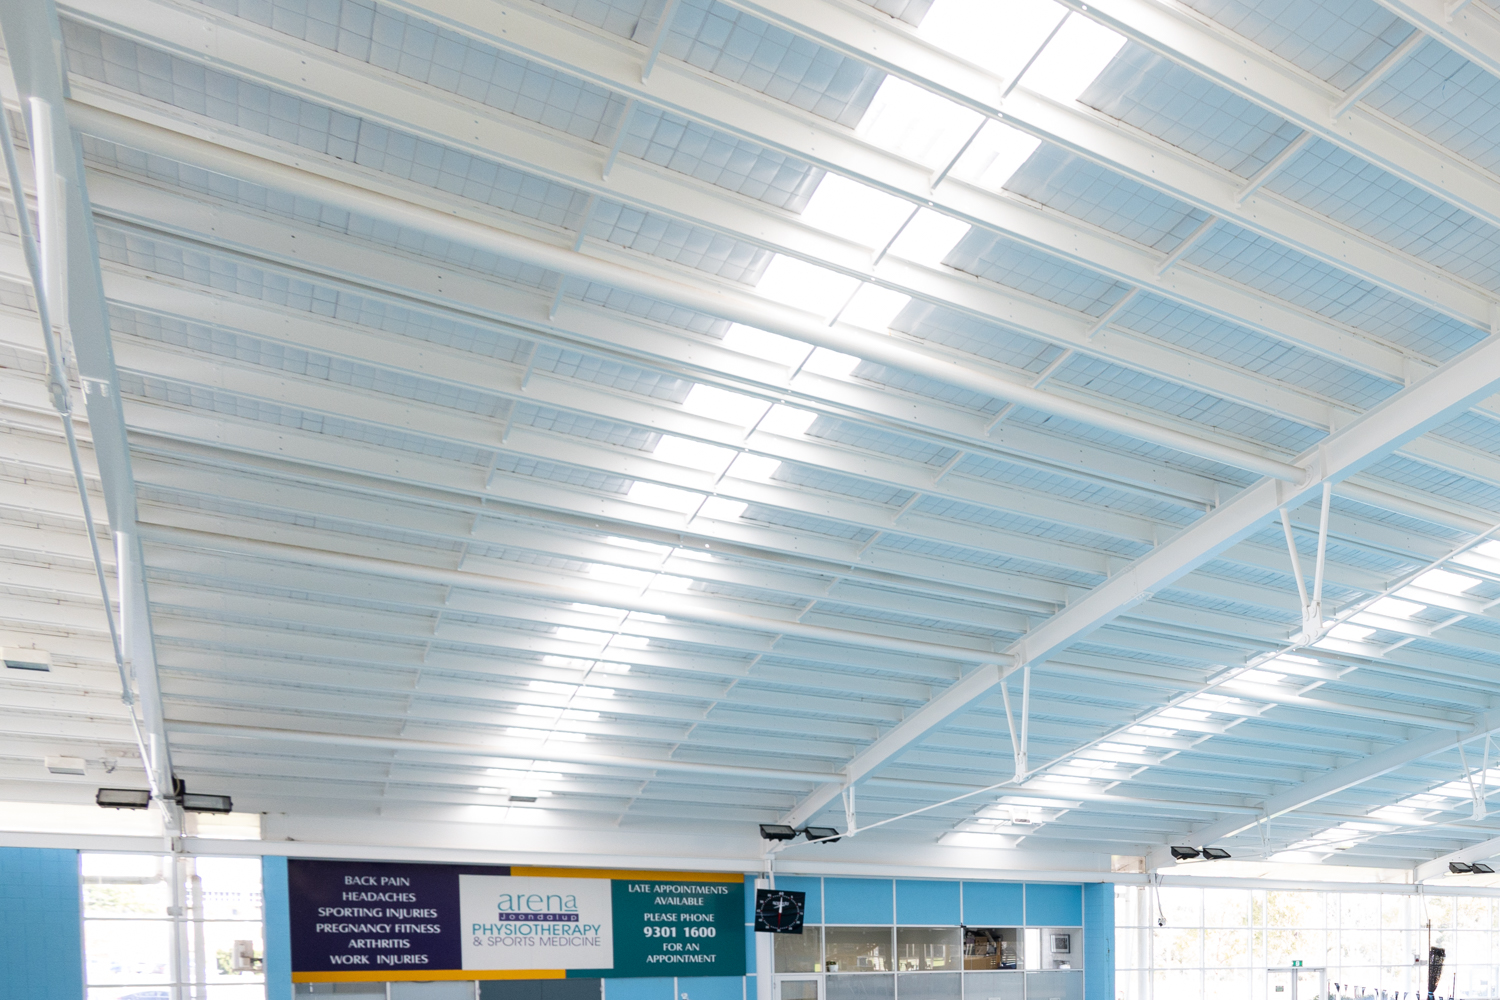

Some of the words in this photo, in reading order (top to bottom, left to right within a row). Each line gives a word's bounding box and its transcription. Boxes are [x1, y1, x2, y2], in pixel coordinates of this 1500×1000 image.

[344, 875, 378, 886] BACK
[381, 876, 411, 887] PAIN
[628, 884, 651, 893] LATE
[653, 885, 729, 895] APPOINTMENTS
[342, 891, 417, 902] HEADACHES
[654, 897, 704, 906] AVAILABLE
[497, 893, 579, 912] arena
[317, 907, 383, 917] SPORTING
[386, 908, 438, 919] INJURIES
[500, 913, 578, 921] Joondalup
[643, 913, 678, 922] PLEASE
[680, 913, 715, 922] PHONE
[316, 923, 392, 933] PREGNANCY
[395, 924, 441, 934] FITNESS
[472, 923, 601, 936] PHYSIOTHERAPY
[643, 926, 677, 938] 9301
[683, 926, 717, 938] 1600
[348, 938, 411, 949] ARTHRITIS
[472, 936, 483, 947] &
[487, 936, 535, 947] SPORTS
[539, 936, 601, 947] MEDICINE
[663, 942, 683, 951] FOR
[684, 942, 700, 951] AN
[329, 955, 370, 965] WORK
[376, 954, 430, 966] INJURIES
[646, 954, 717, 963] APPOINTMENT
